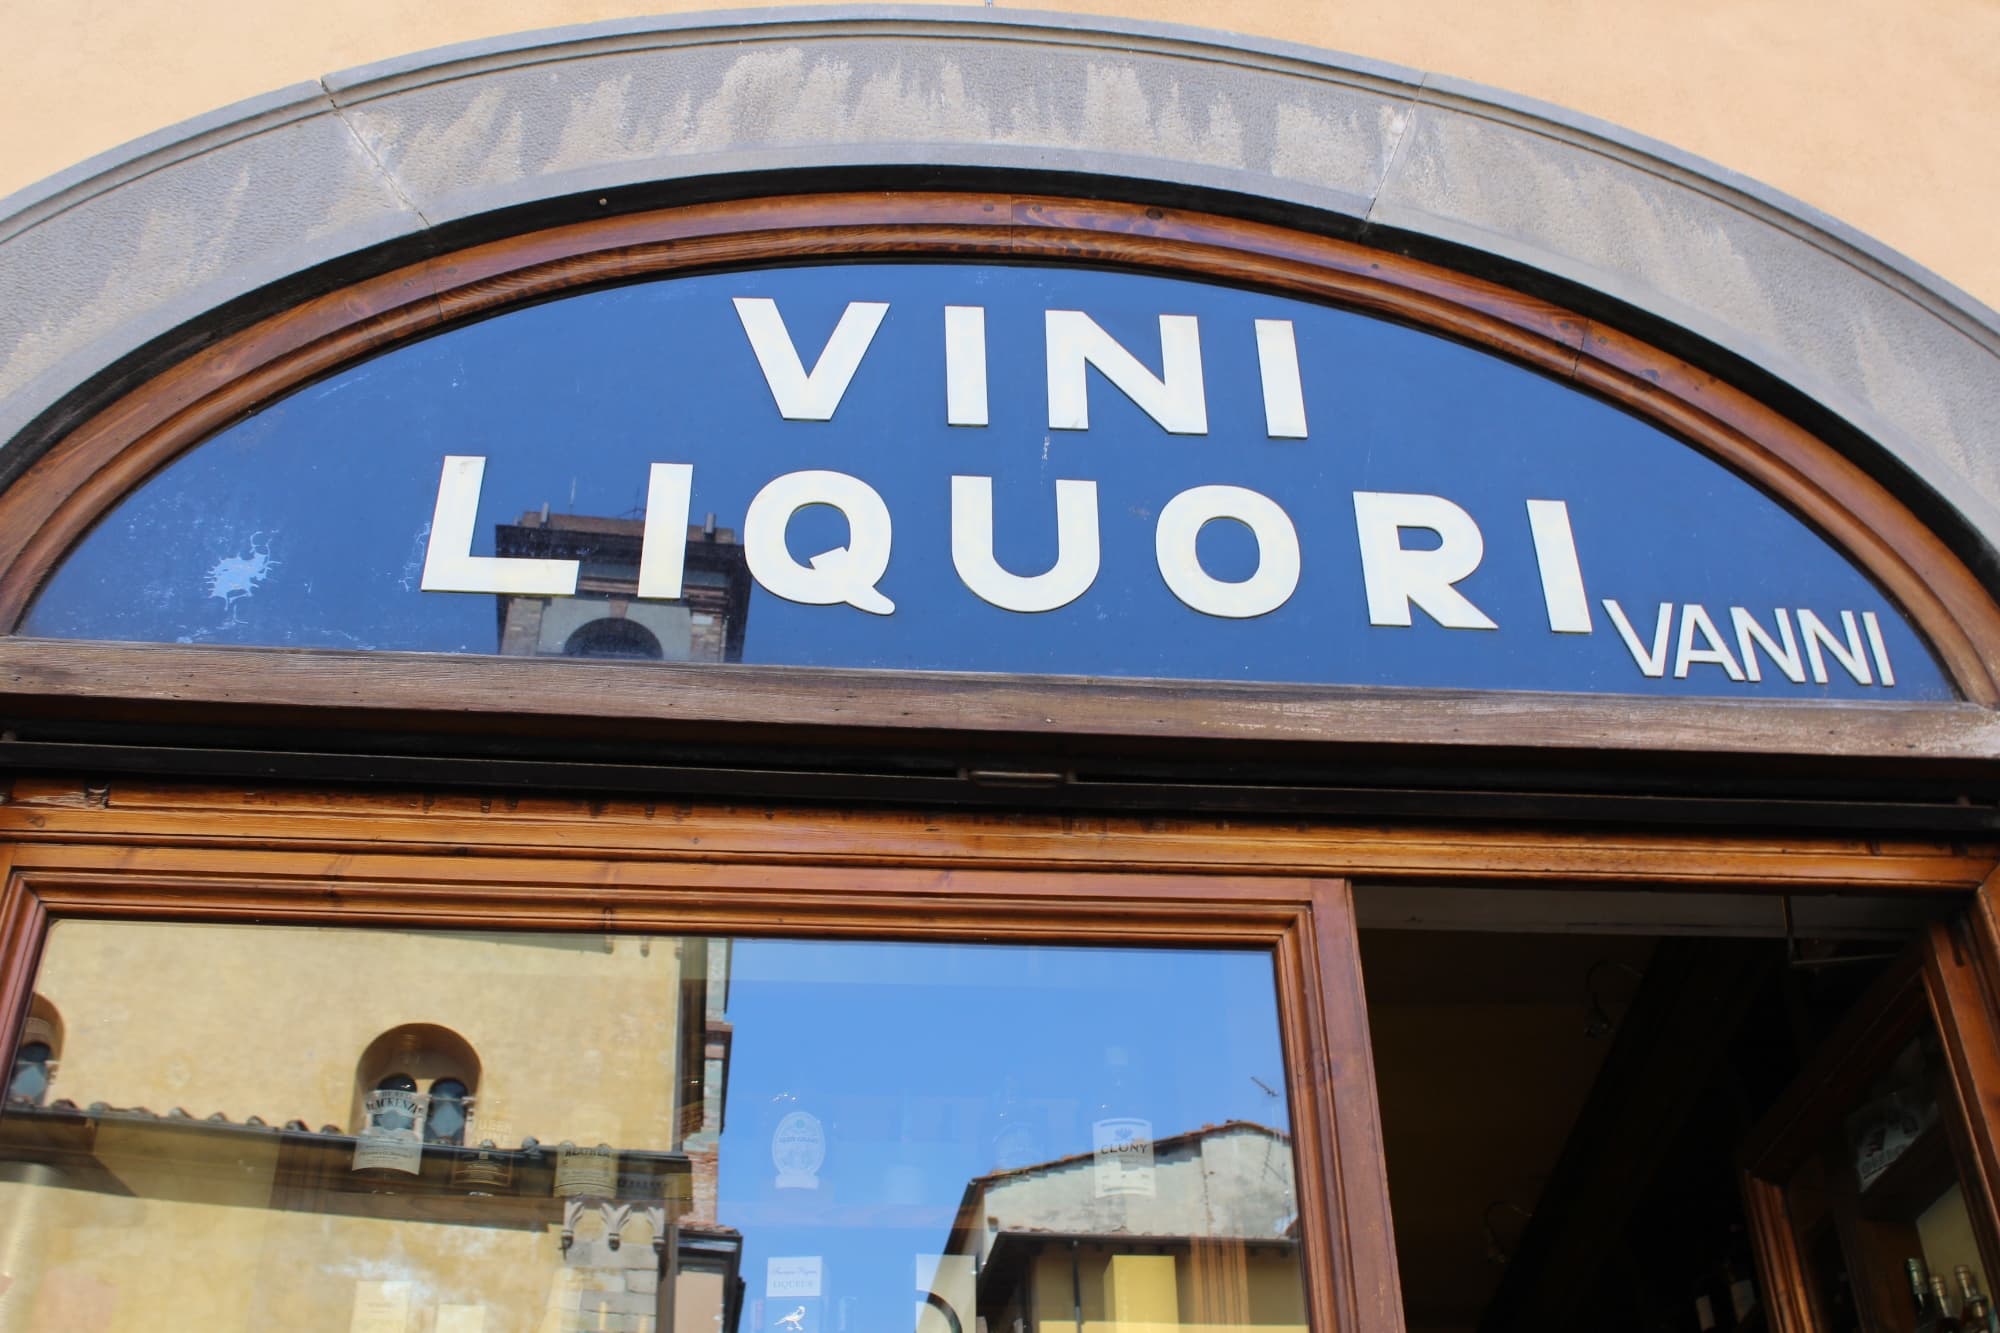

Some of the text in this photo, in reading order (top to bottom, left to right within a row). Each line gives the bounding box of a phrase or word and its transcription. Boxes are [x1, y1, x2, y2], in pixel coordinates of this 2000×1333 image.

[733, 297, 1309, 439] VINI
[420, 455, 1594, 634] LIQUORI
[1602, 599, 1896, 687] VANNI
[1100, 1143, 1147, 1154] CLUNY
